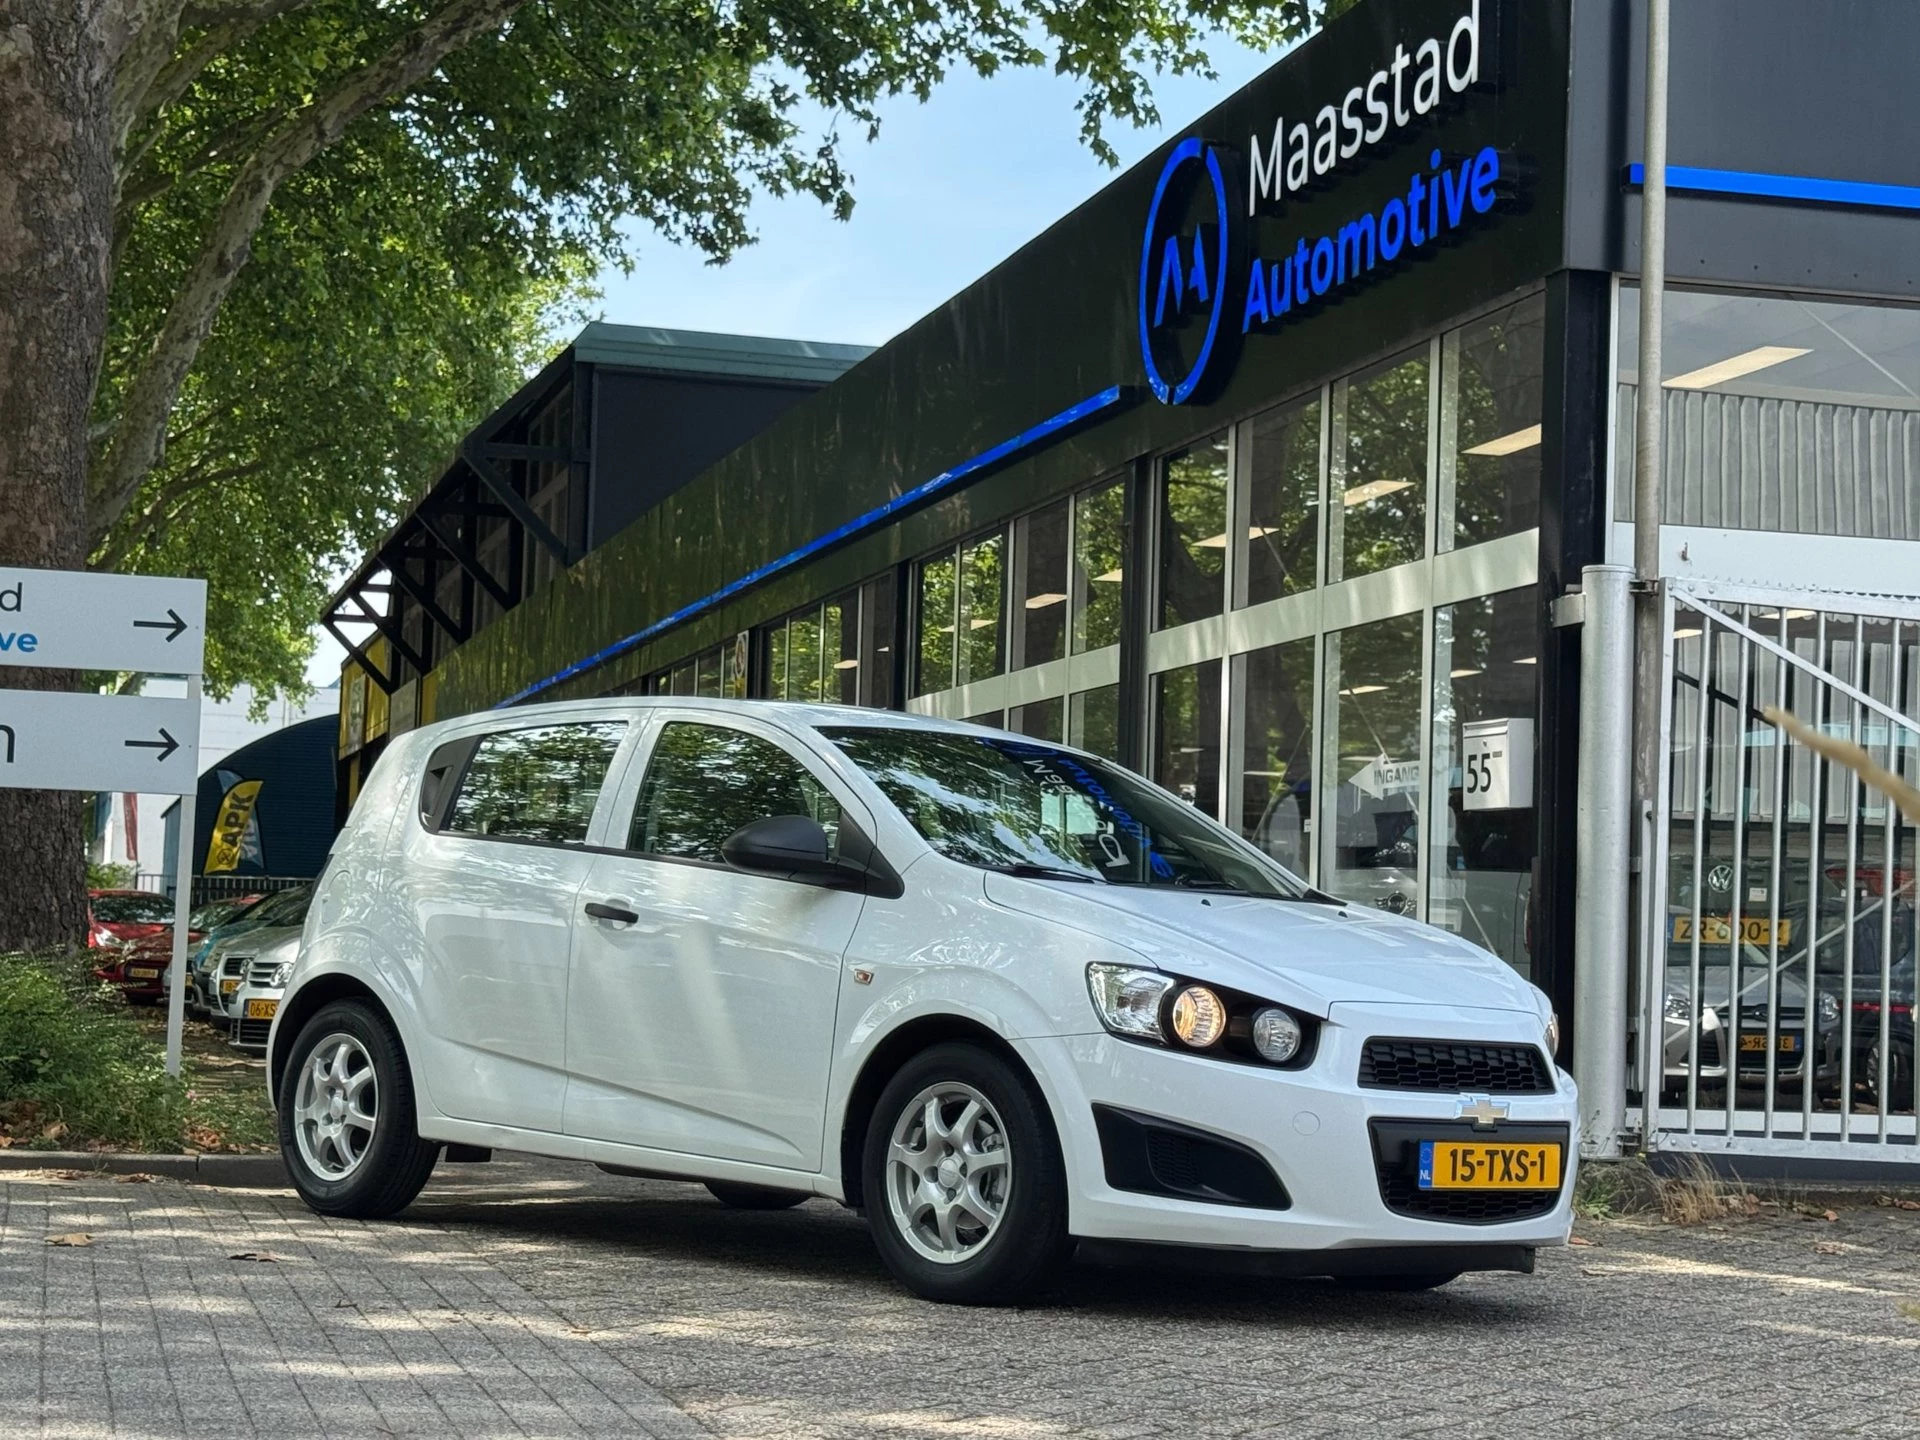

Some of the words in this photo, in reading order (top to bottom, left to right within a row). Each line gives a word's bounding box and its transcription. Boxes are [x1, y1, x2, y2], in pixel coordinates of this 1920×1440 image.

[1249, 0, 1480, 217] Maasstad
[1242, 146, 1500, 334] Automotive
[1373, 765, 1420, 785] INGANG
[1466, 752, 1492, 794] 55
[1420, 1169, 1431, 1180] NL
[1449, 1148, 1546, 1182] 15-TXS-1
